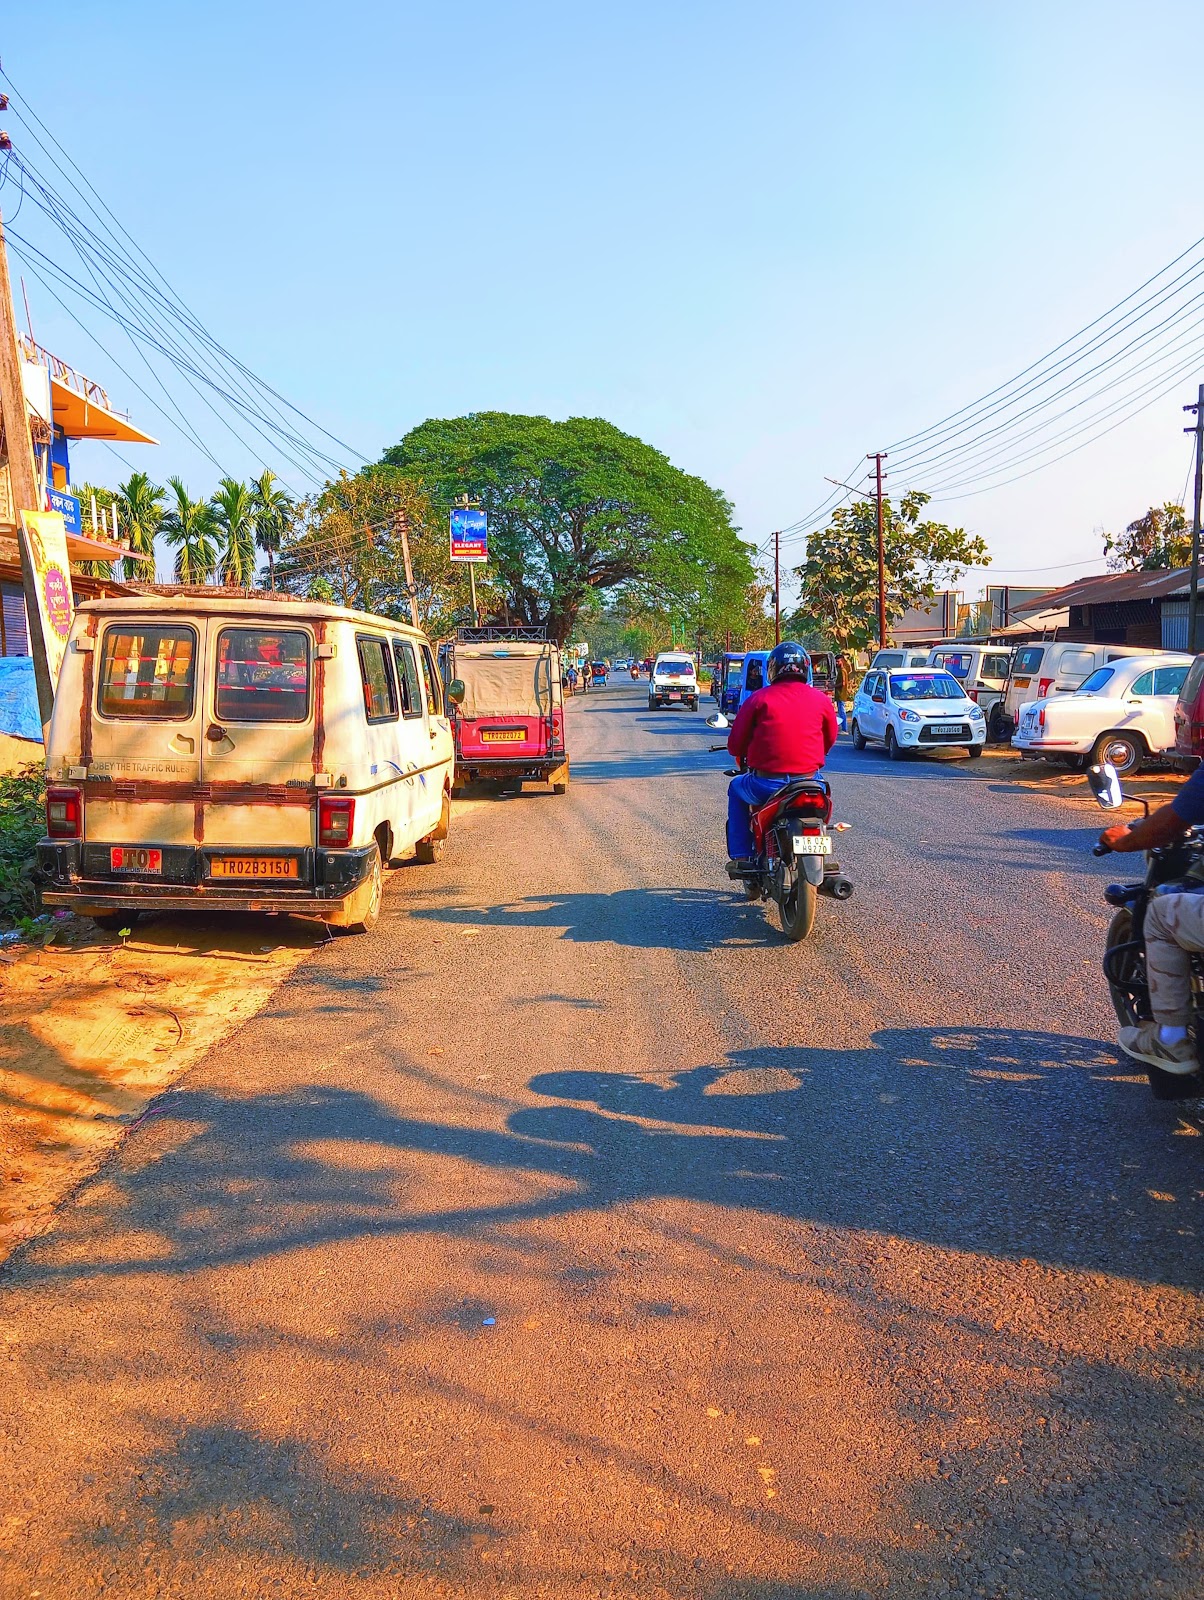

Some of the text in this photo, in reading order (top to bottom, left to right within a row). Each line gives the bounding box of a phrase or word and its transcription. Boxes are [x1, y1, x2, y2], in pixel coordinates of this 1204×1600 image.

[93, 762, 190, 773] OBEY THE TRAFFIC RULES
[802, 845, 827, 854] H9270
[112, 848, 160, 868] STOP
[222, 861, 290, 874] TR02B3150
